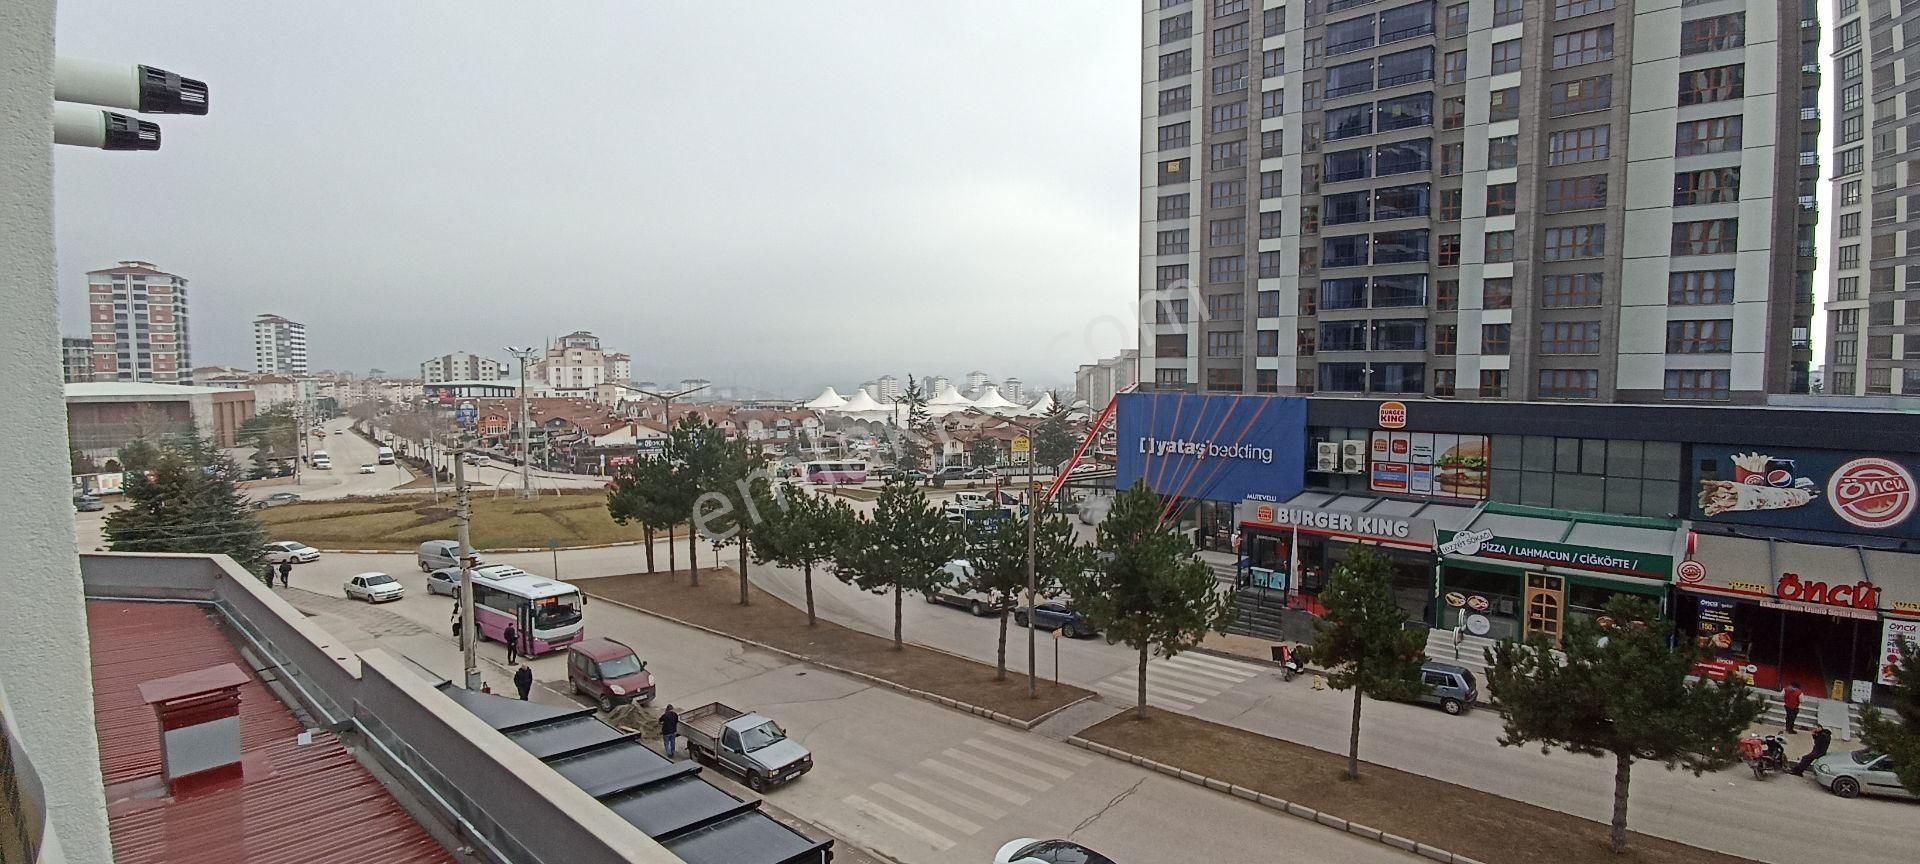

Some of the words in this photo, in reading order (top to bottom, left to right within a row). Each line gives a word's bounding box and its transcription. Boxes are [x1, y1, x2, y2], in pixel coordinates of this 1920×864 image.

[1380, 415, 1405, 423] KING
[1208, 442, 1273, 464] bedding
[1277, 508, 1353, 531] BURGER
[1357, 516, 1409, 538] KING
[1481, 542, 1506, 554] PİZZA
[1515, 546, 1570, 563] LAHMACUN
